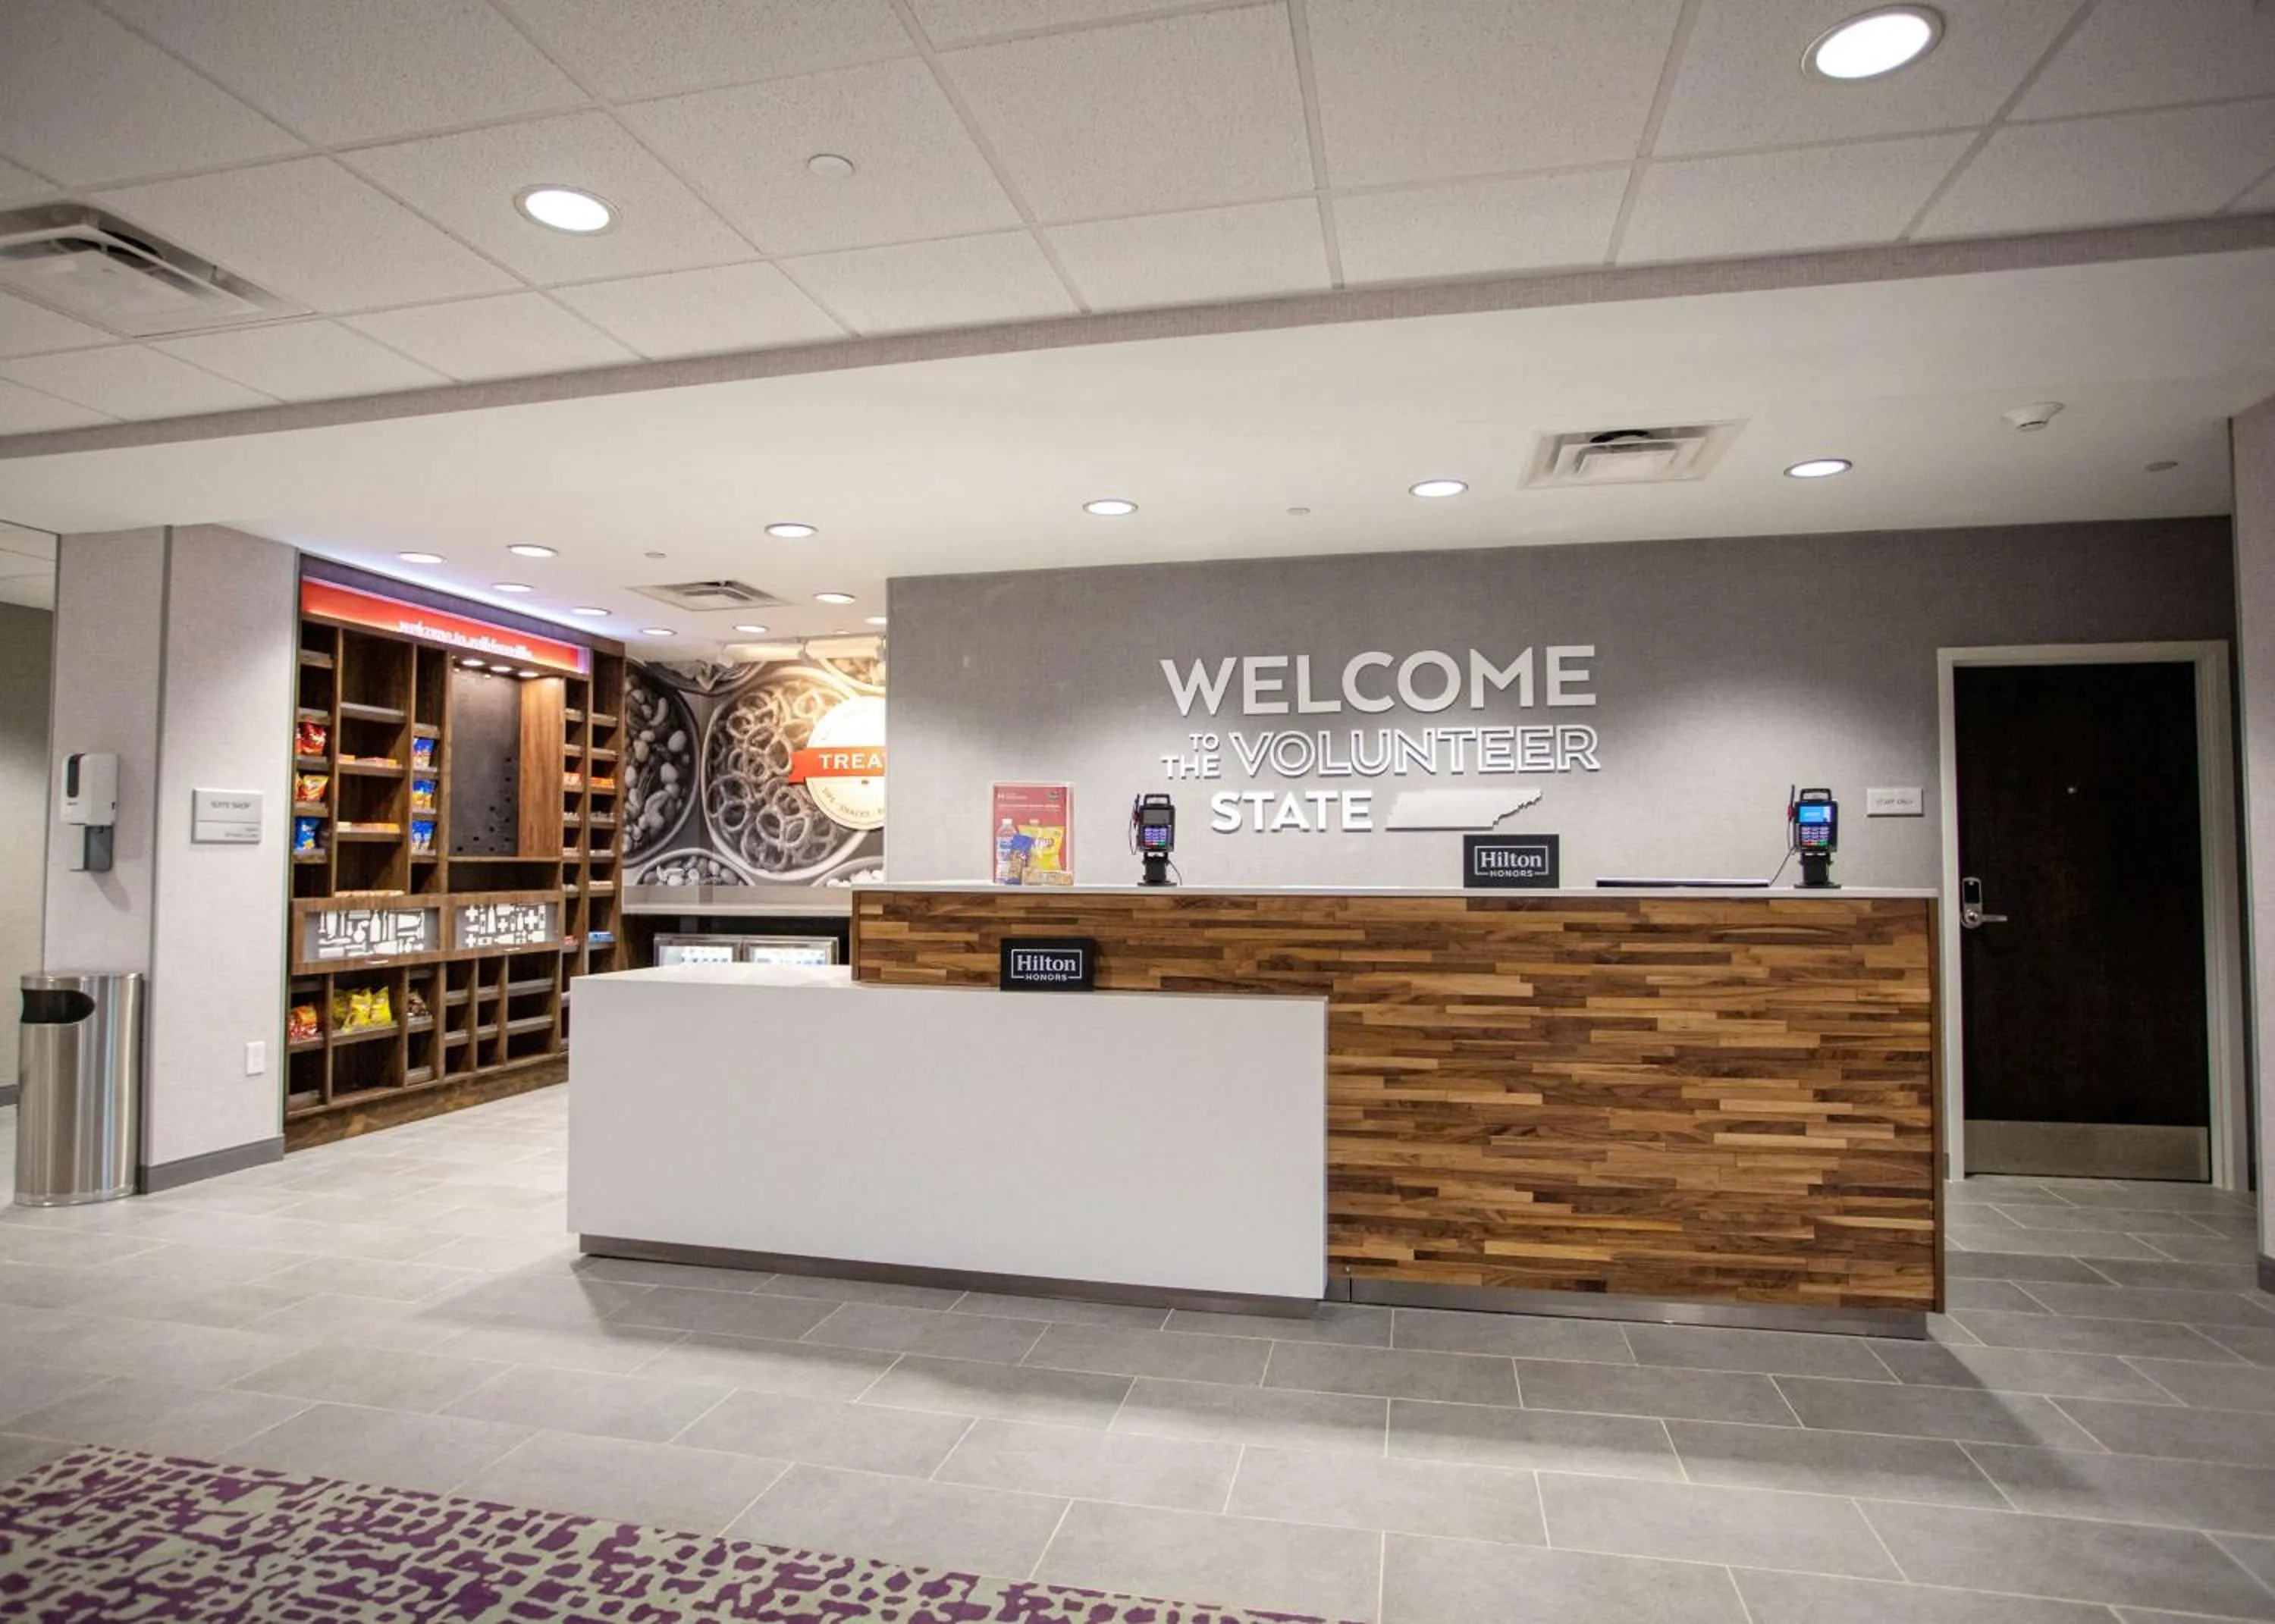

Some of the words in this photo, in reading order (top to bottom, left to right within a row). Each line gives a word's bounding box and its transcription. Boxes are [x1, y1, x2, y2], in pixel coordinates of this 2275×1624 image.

[1159, 645, 1596, 717] WELCOME
[1188, 732, 1220, 751] TO
[1161, 754, 1221, 779] THE
[1228, 724, 1602, 778] VOLUNTEER
[818, 754, 886, 770] TREA
[1210, 790, 1373, 833] STATE
[1480, 851, 1542, 868] Hilton
[1017, 955, 1076, 971] Hilton
[1025, 973, 1068, 982] HONORS
